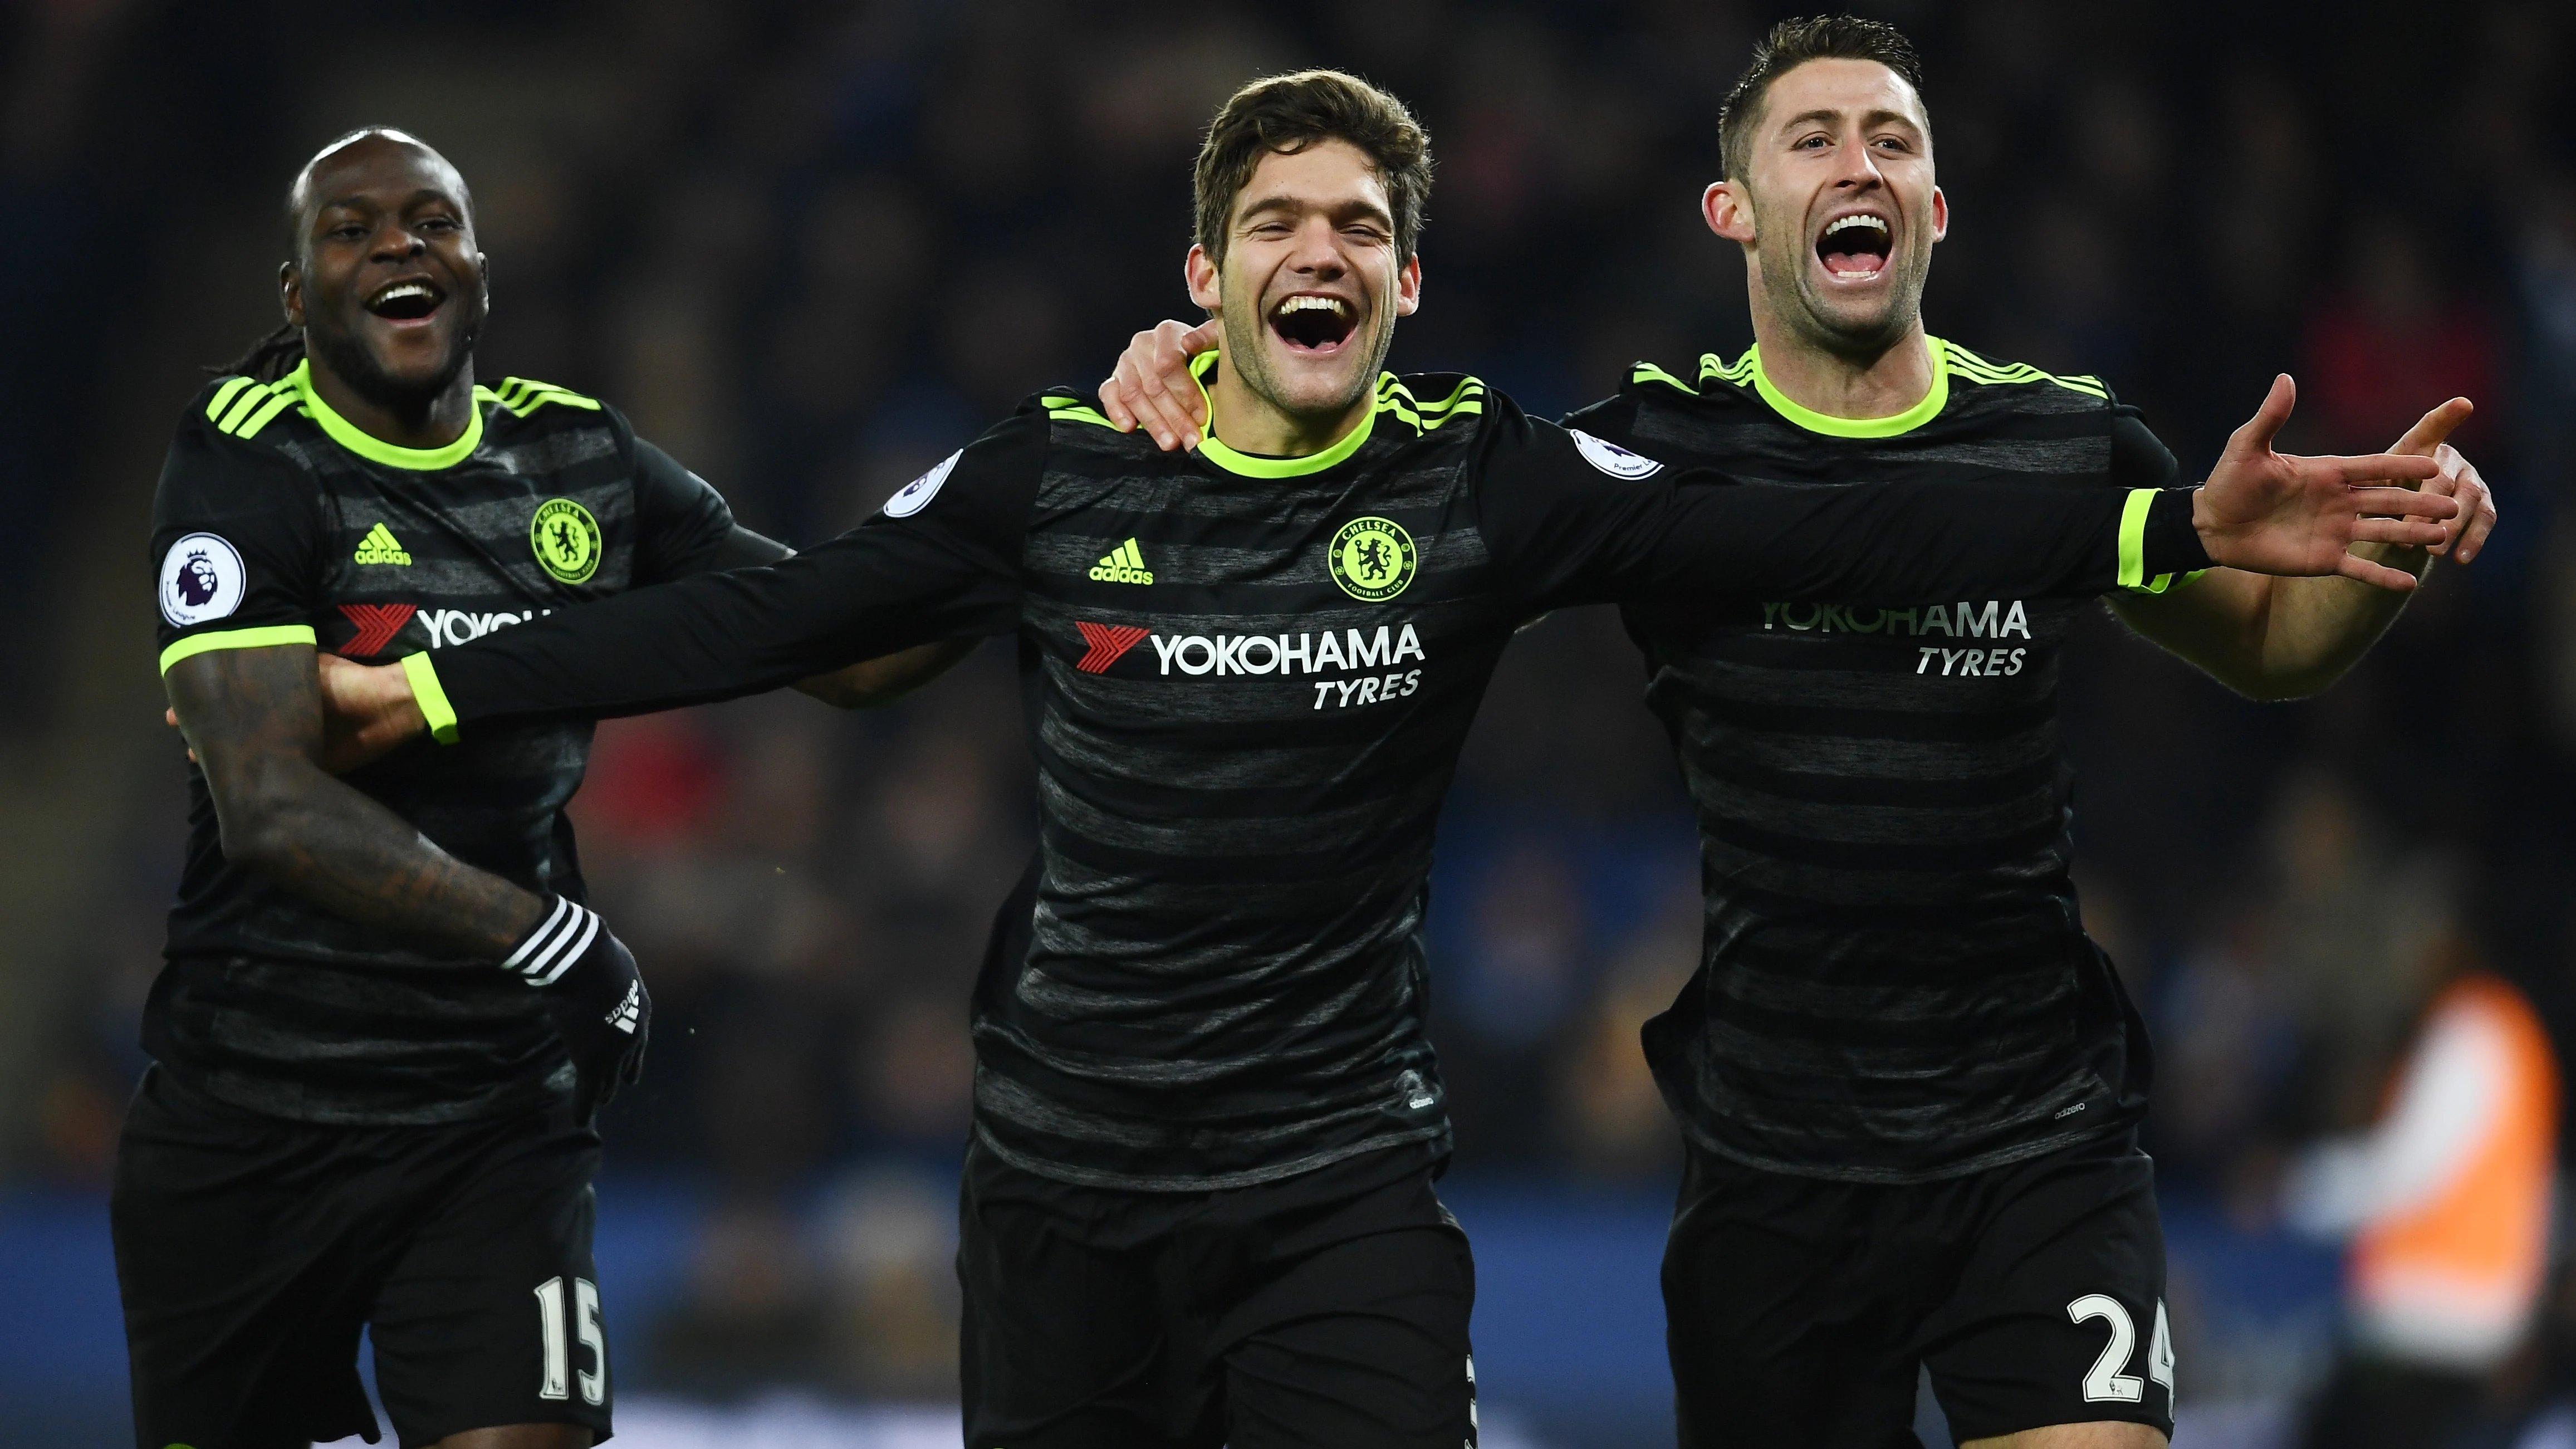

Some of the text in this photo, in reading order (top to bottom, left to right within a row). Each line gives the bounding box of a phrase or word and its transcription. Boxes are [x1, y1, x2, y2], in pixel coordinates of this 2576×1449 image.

[1614, 463, 1643, 471] Premier
[1342, 521, 1396, 540] CHELSEA
[354, 546, 413, 566] adidas
[1089, 565, 1154, 585] adidas
[1347, 579, 1404, 596] FOOTBALL CLUB
[1761, 600, 2031, 639] YOKOHAMA
[1150, 623, 1425, 676] YOKOHAMA
[1916, 647, 2026, 677] TYRES
[1314, 669, 1422, 711] TYRES
[605, 978, 639, 1024] adidas
[533, 1276, 606, 1406] 15
[2066, 1293, 2176, 1424] 24
